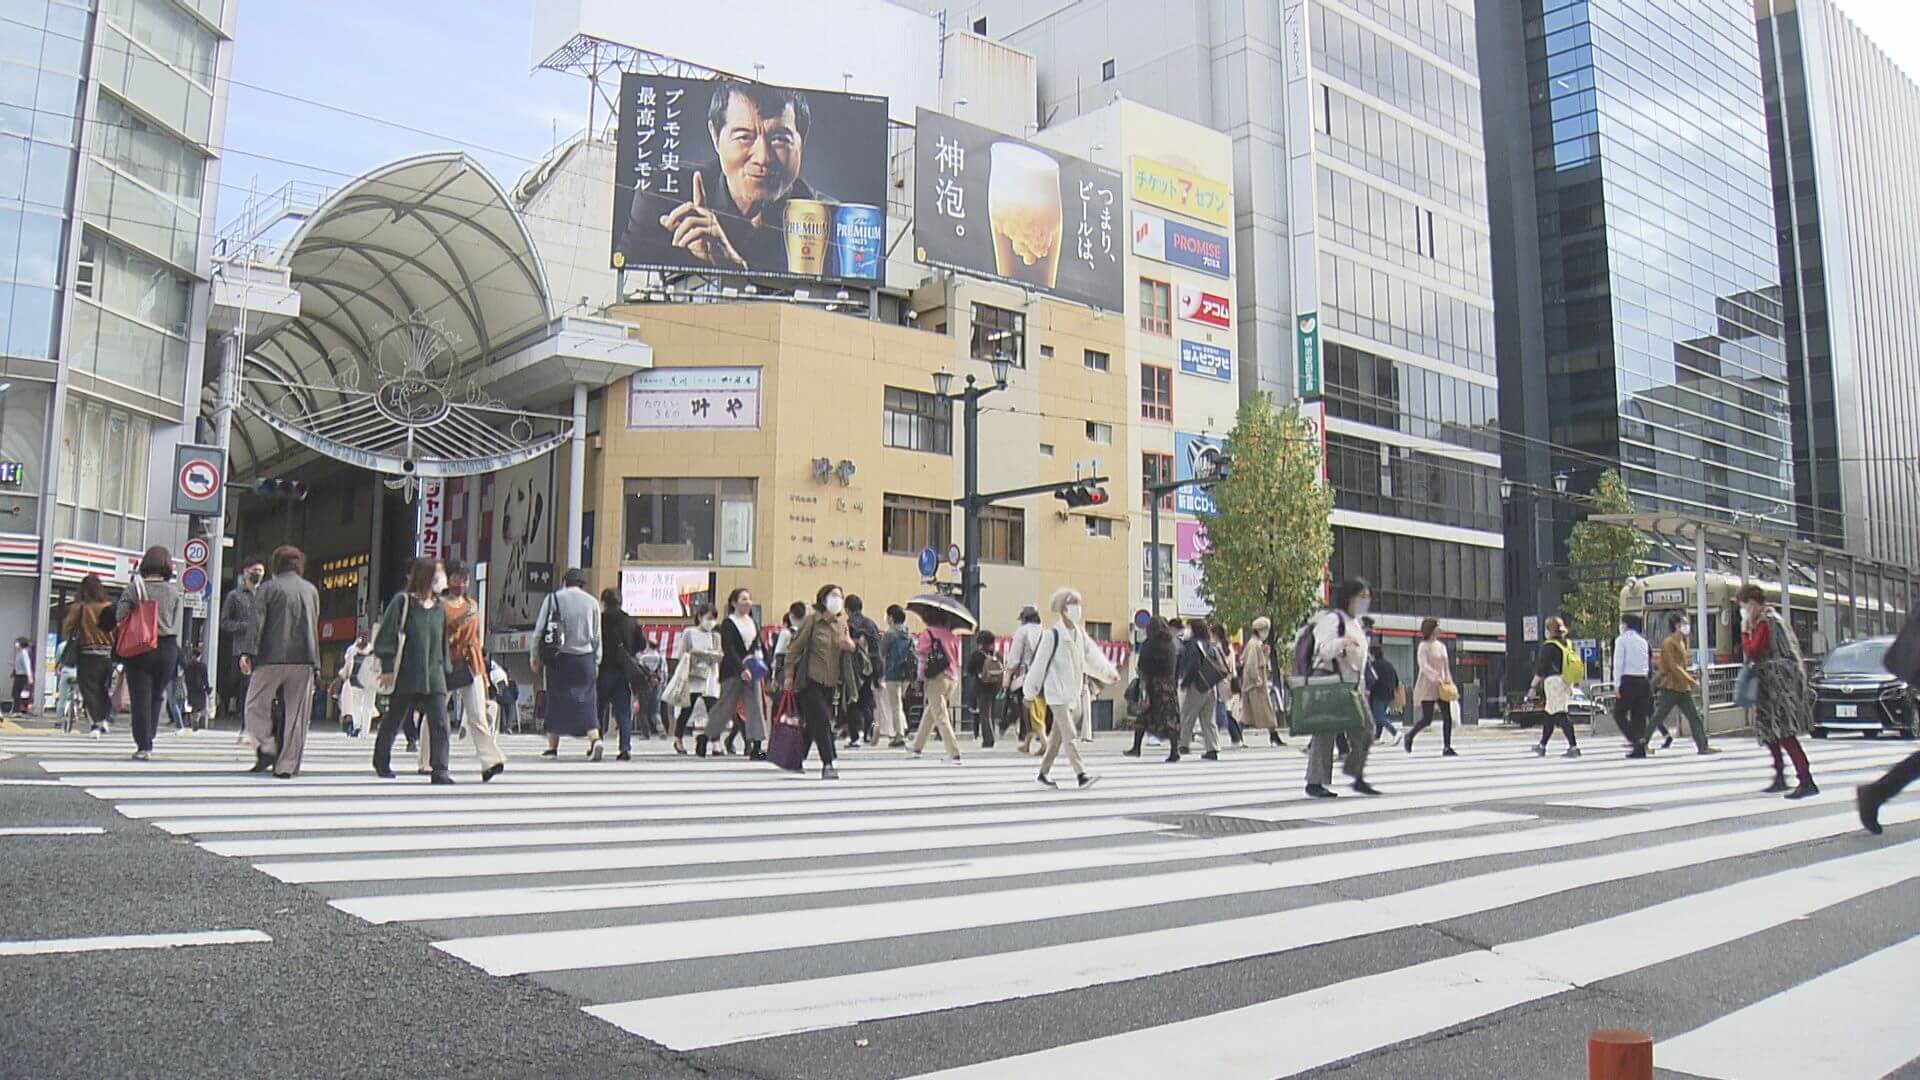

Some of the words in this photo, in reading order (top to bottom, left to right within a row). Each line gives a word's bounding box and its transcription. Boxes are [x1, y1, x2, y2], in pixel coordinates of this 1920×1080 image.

[633, 86, 657, 190] 最高プレモル
[659, 88, 684, 193] プレモル史上
[934, 136, 966, 236] 神泡。
[837, 223, 881, 240] PREMIUM
[1077, 180, 1095, 269] ビールは、
[1098, 189, 1116, 262] つまり、
[1173, 233, 1222, 259] PROMISE
[1202, 300, 1229, 319] アコム
[189, 546, 203, 559] 20
[423, 481, 440, 560] ジャンカラ
